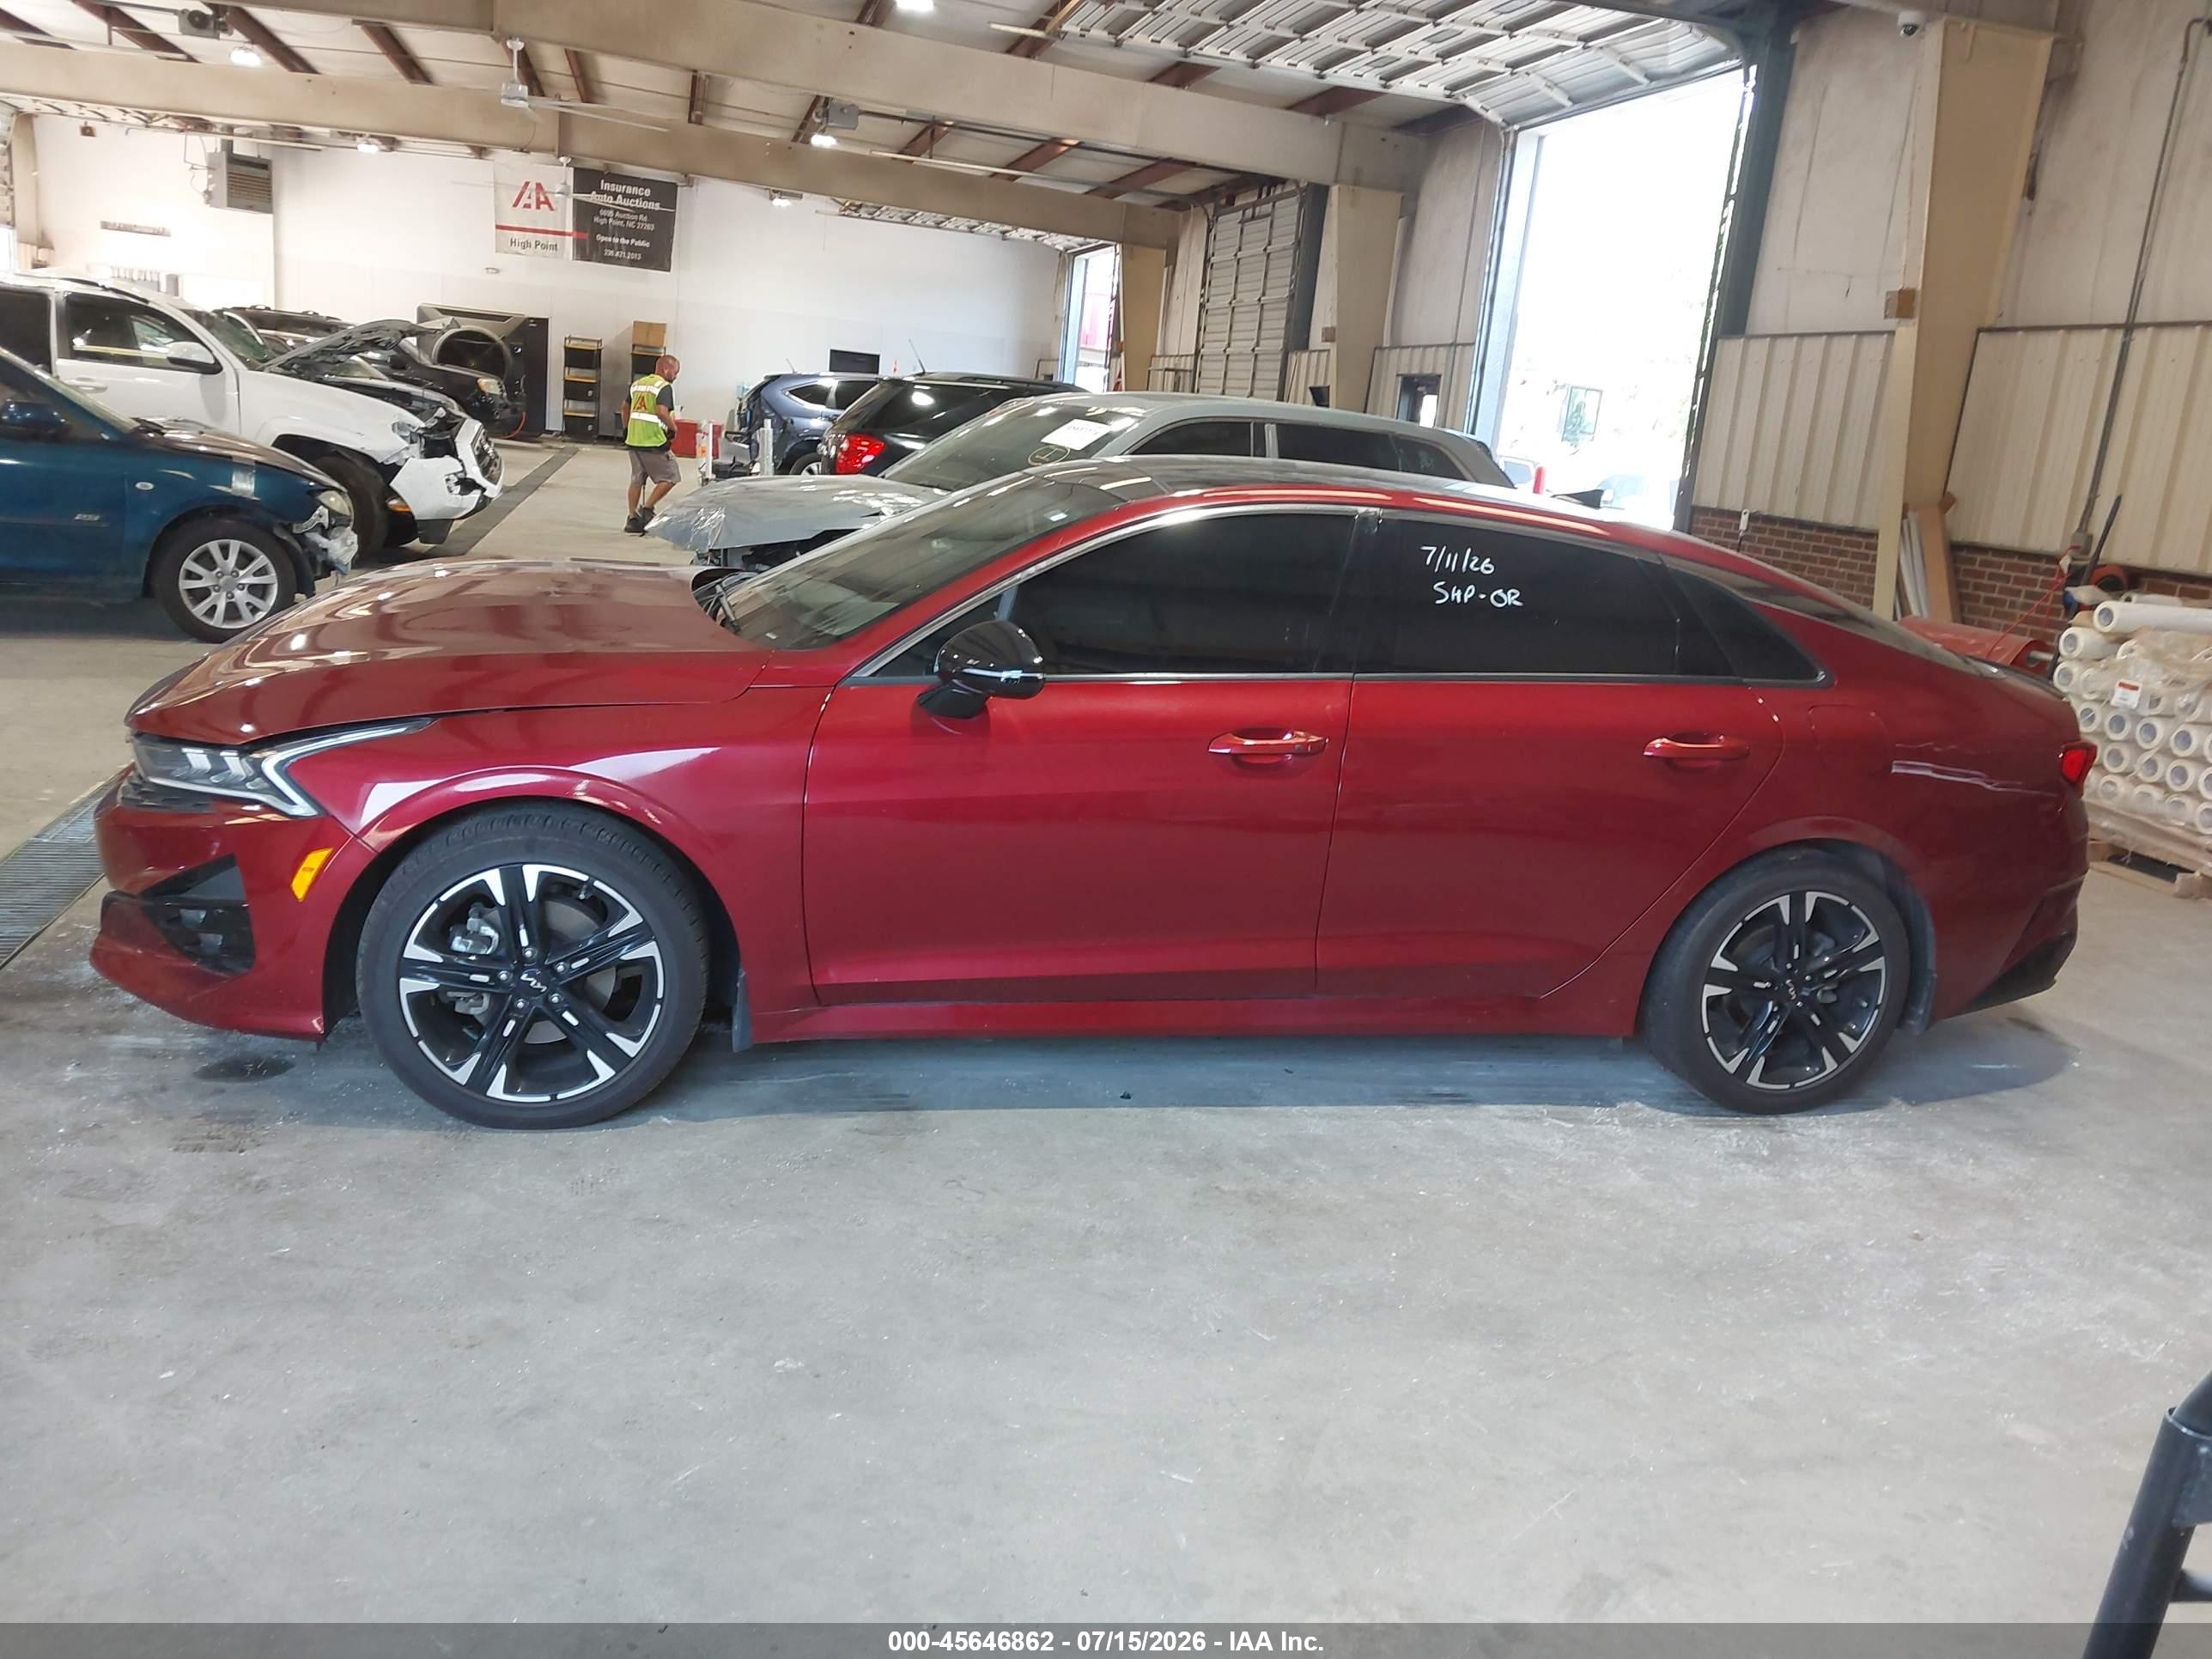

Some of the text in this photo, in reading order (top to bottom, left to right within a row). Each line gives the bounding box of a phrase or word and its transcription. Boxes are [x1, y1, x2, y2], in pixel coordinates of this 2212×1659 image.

[600, 179, 651, 197] Insurance
[591, 191, 660, 210] Auto Auctions
[510, 237, 558, 251] High Point
[596, 234, 611, 242] Open
[630, 238, 650, 247] Public
[1420, 545, 1495, 574] 7/11/26
